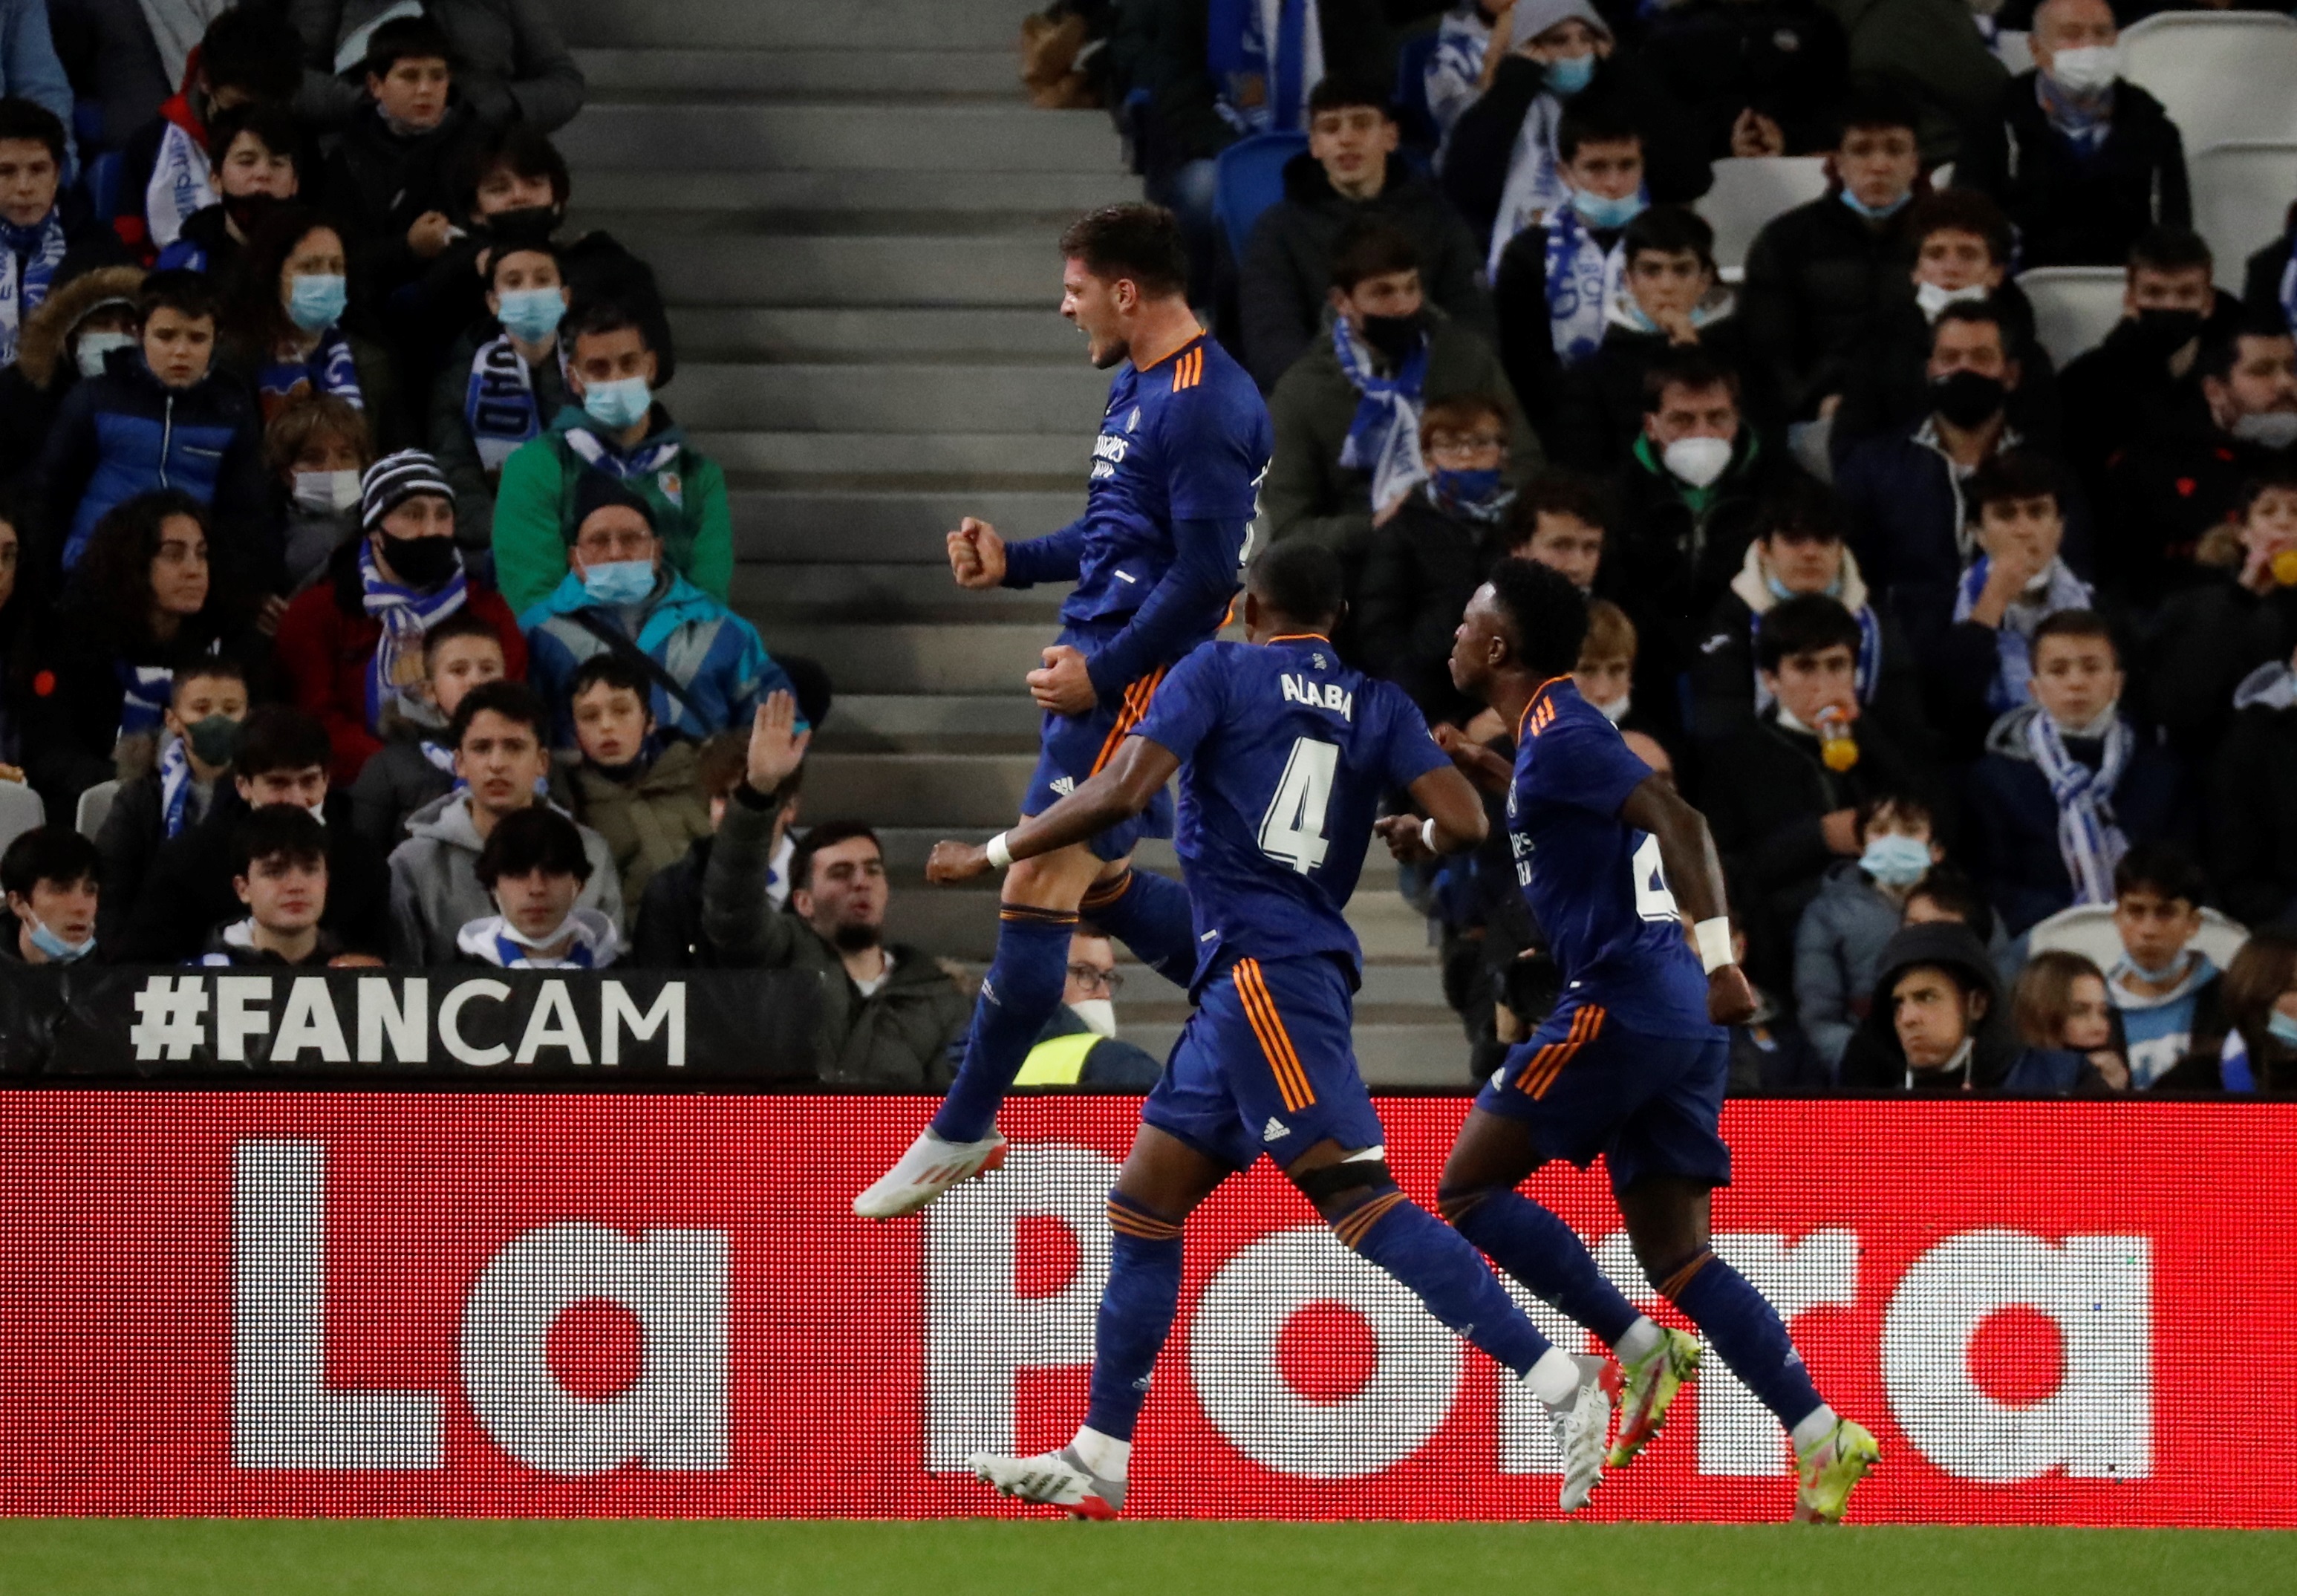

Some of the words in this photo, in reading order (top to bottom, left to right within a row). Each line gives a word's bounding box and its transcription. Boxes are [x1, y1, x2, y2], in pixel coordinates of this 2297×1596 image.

[1280, 673, 1352, 722] ALABA
[1258, 736, 1339, 876] 4
[131, 975, 686, 1066] #FANCAM
[232, 1139, 731, 1476] La
